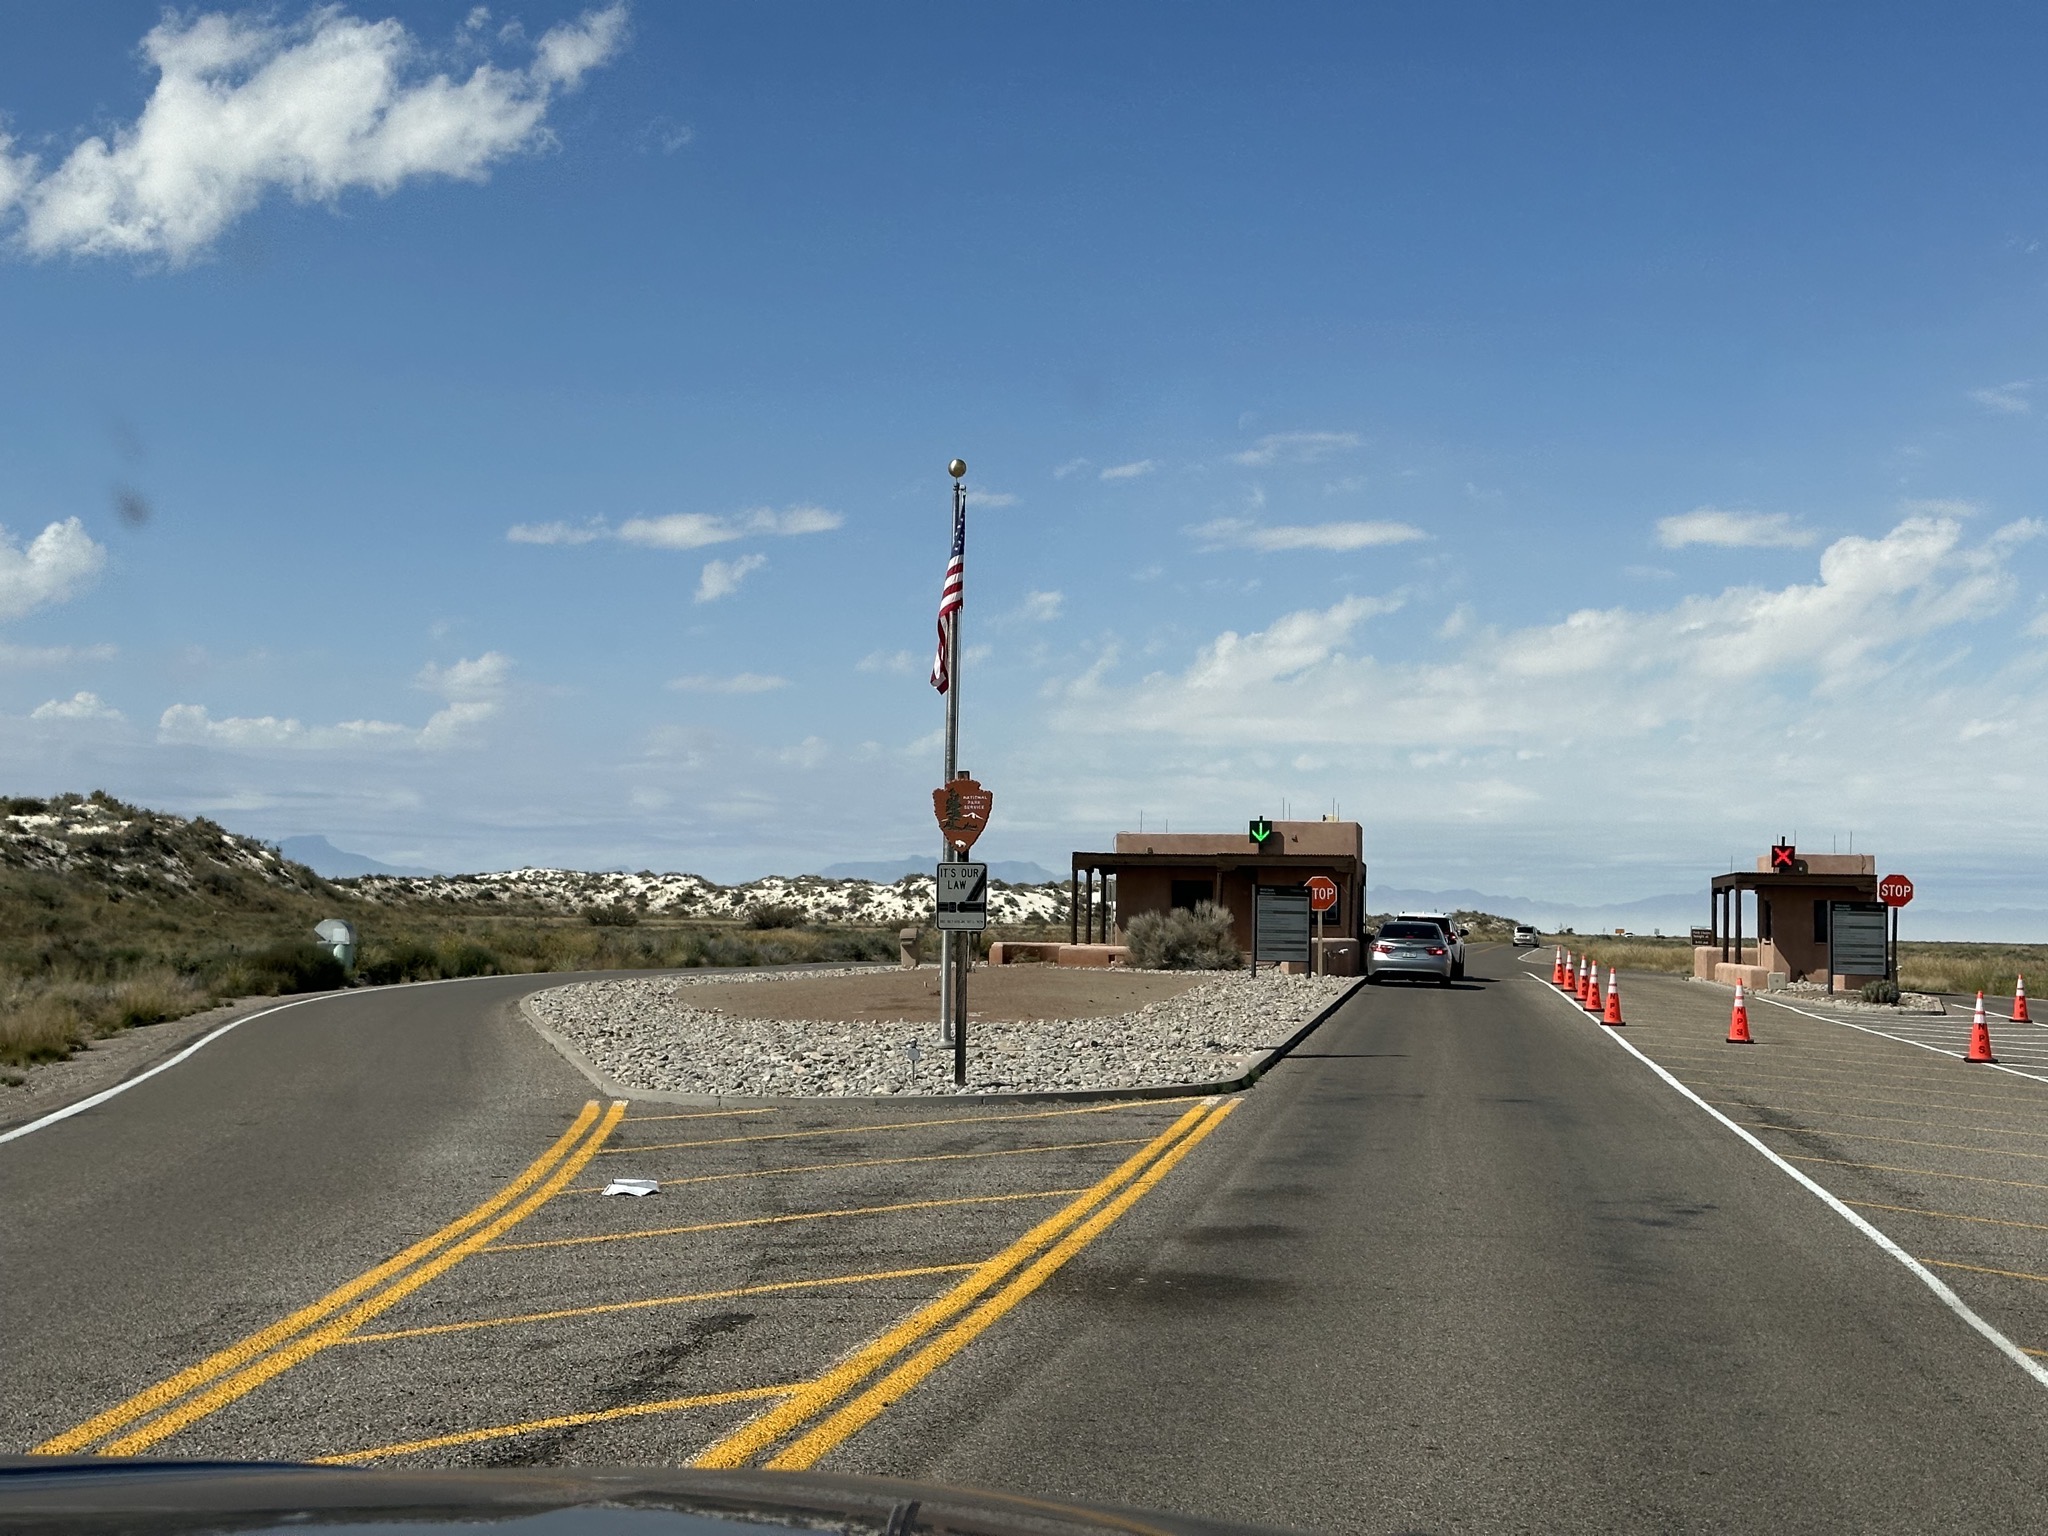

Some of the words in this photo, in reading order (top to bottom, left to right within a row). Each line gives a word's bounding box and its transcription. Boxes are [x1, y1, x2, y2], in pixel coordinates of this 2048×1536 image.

[940, 868, 956, 878] IT'S
[961, 868, 979, 878] OUR
[947, 880, 967, 890] LAW
[1881, 884, 1911, 897] STOP
[1312, 887, 1334, 900] TOP
[1736, 1007, 1744, 1036] NPS
[1978, 1024, 1986, 1054] NPS
